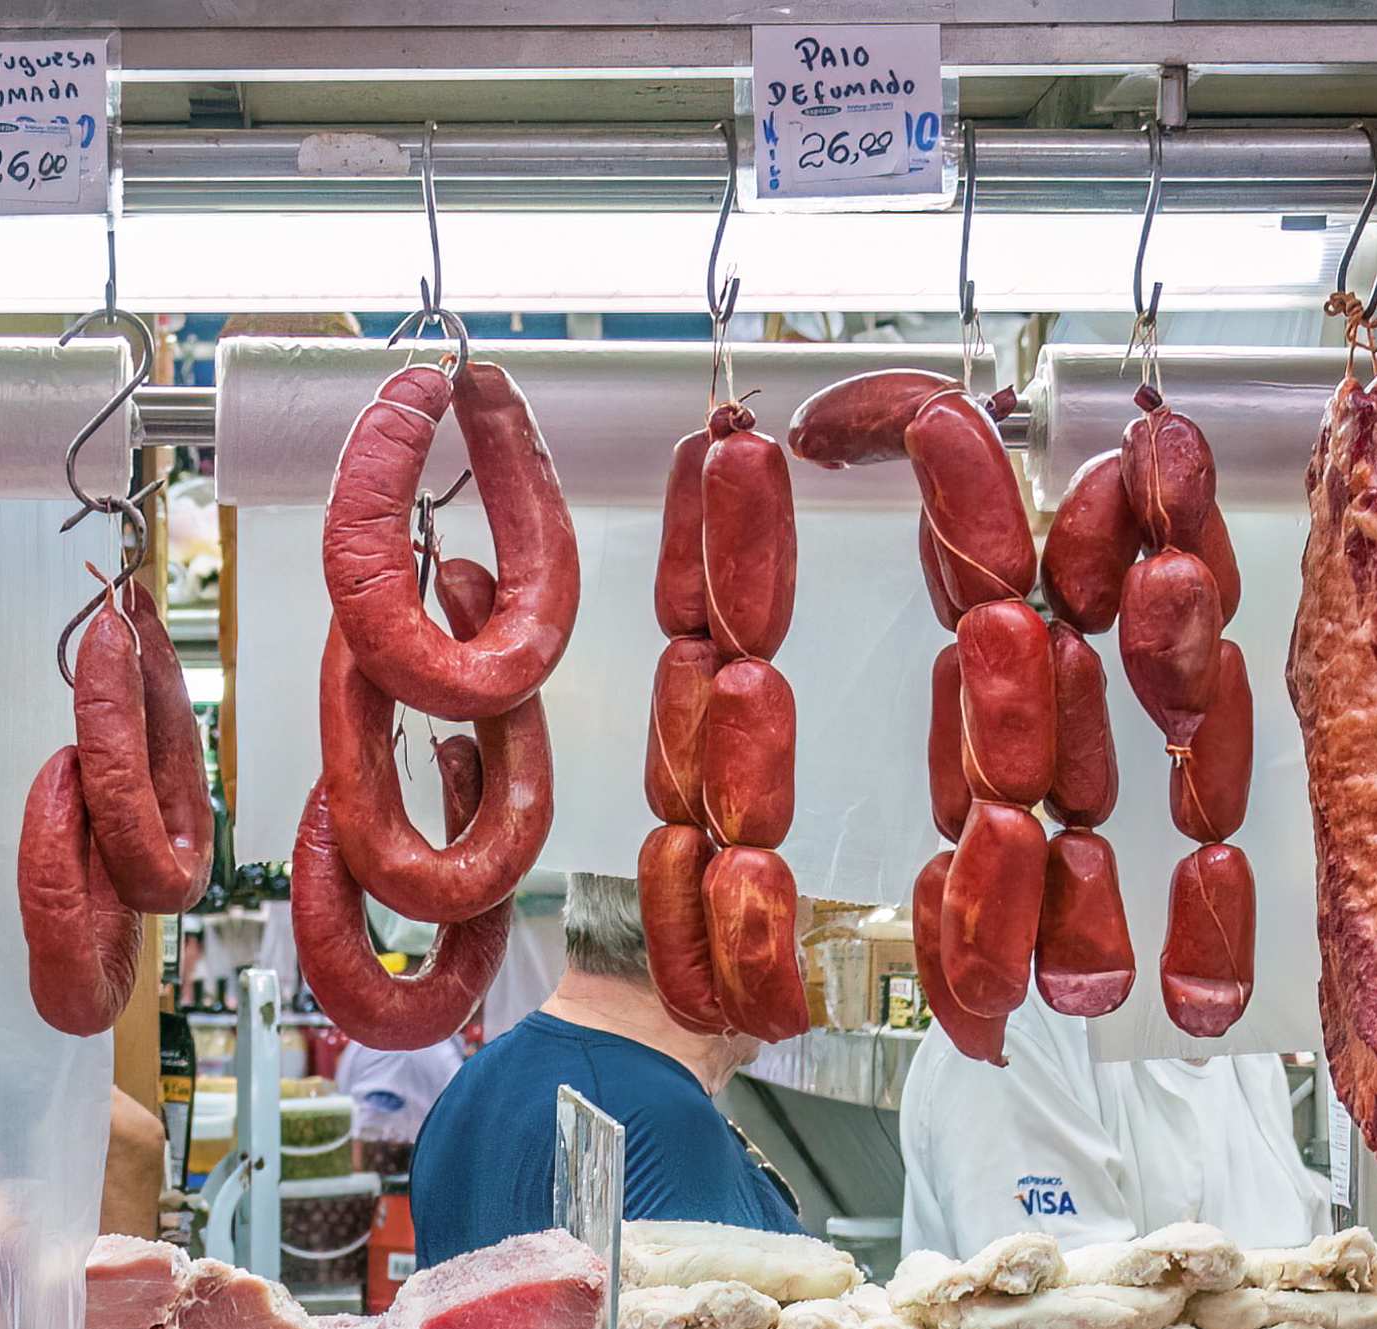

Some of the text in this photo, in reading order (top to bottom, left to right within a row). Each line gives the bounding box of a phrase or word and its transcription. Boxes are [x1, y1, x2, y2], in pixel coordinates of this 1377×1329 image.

[794, 37, 869, 72] PAIO
[799, 131, 893, 169] 26,00
[1019, 1188, 1077, 1216] VISA
